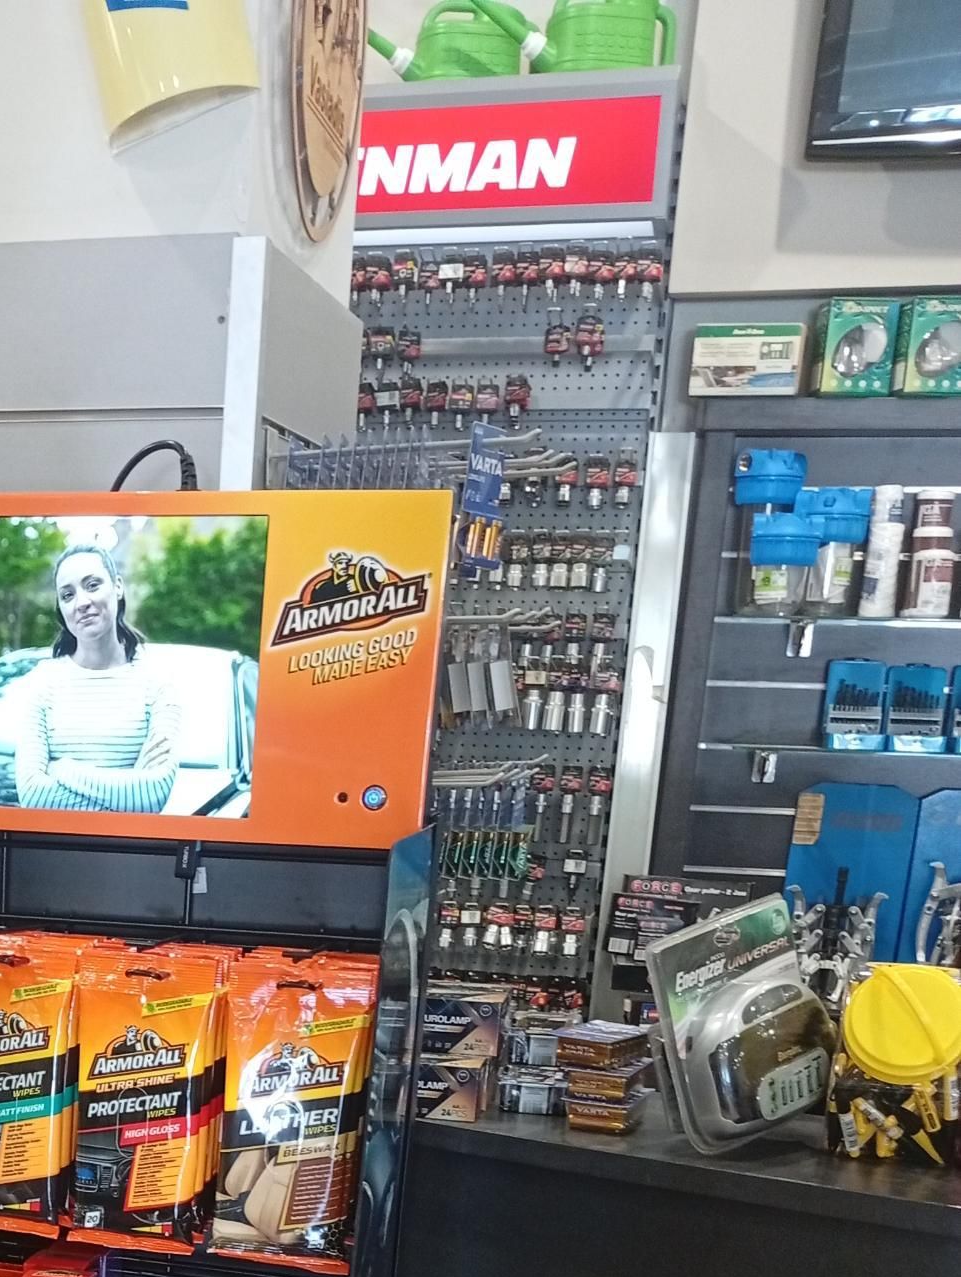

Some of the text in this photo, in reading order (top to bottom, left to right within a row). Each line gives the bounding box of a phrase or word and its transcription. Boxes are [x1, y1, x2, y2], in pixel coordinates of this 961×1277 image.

[356, 136, 577, 197] NMAN
[470, 453, 503, 478] VARTA
[288, 628, 418, 674] LOOKING GOOD
[312, 647, 415, 685] MADE EASY
[630, 879, 683, 895] FORCE
[617, 896, 654, 909] FORCE
[675, 936, 791, 993] Energizer UNIVERSAL
[424, 1014, 473, 1026] UROLAMP
[95, 1074, 175, 1094] ULTRA SHINE
[12, 1087, 41, 1098] WIPES
[16, 1103, 45, 1115] FINISH
[87, 1091, 182, 1118] PROTECTANT
[575, 1106, 611, 1117] VARTA
[146, 1107, 176, 1119] WIPES
[124, 1123, 181, 1139] HIGH GLOSS
[304, 1123, 337, 1135] WIPES
